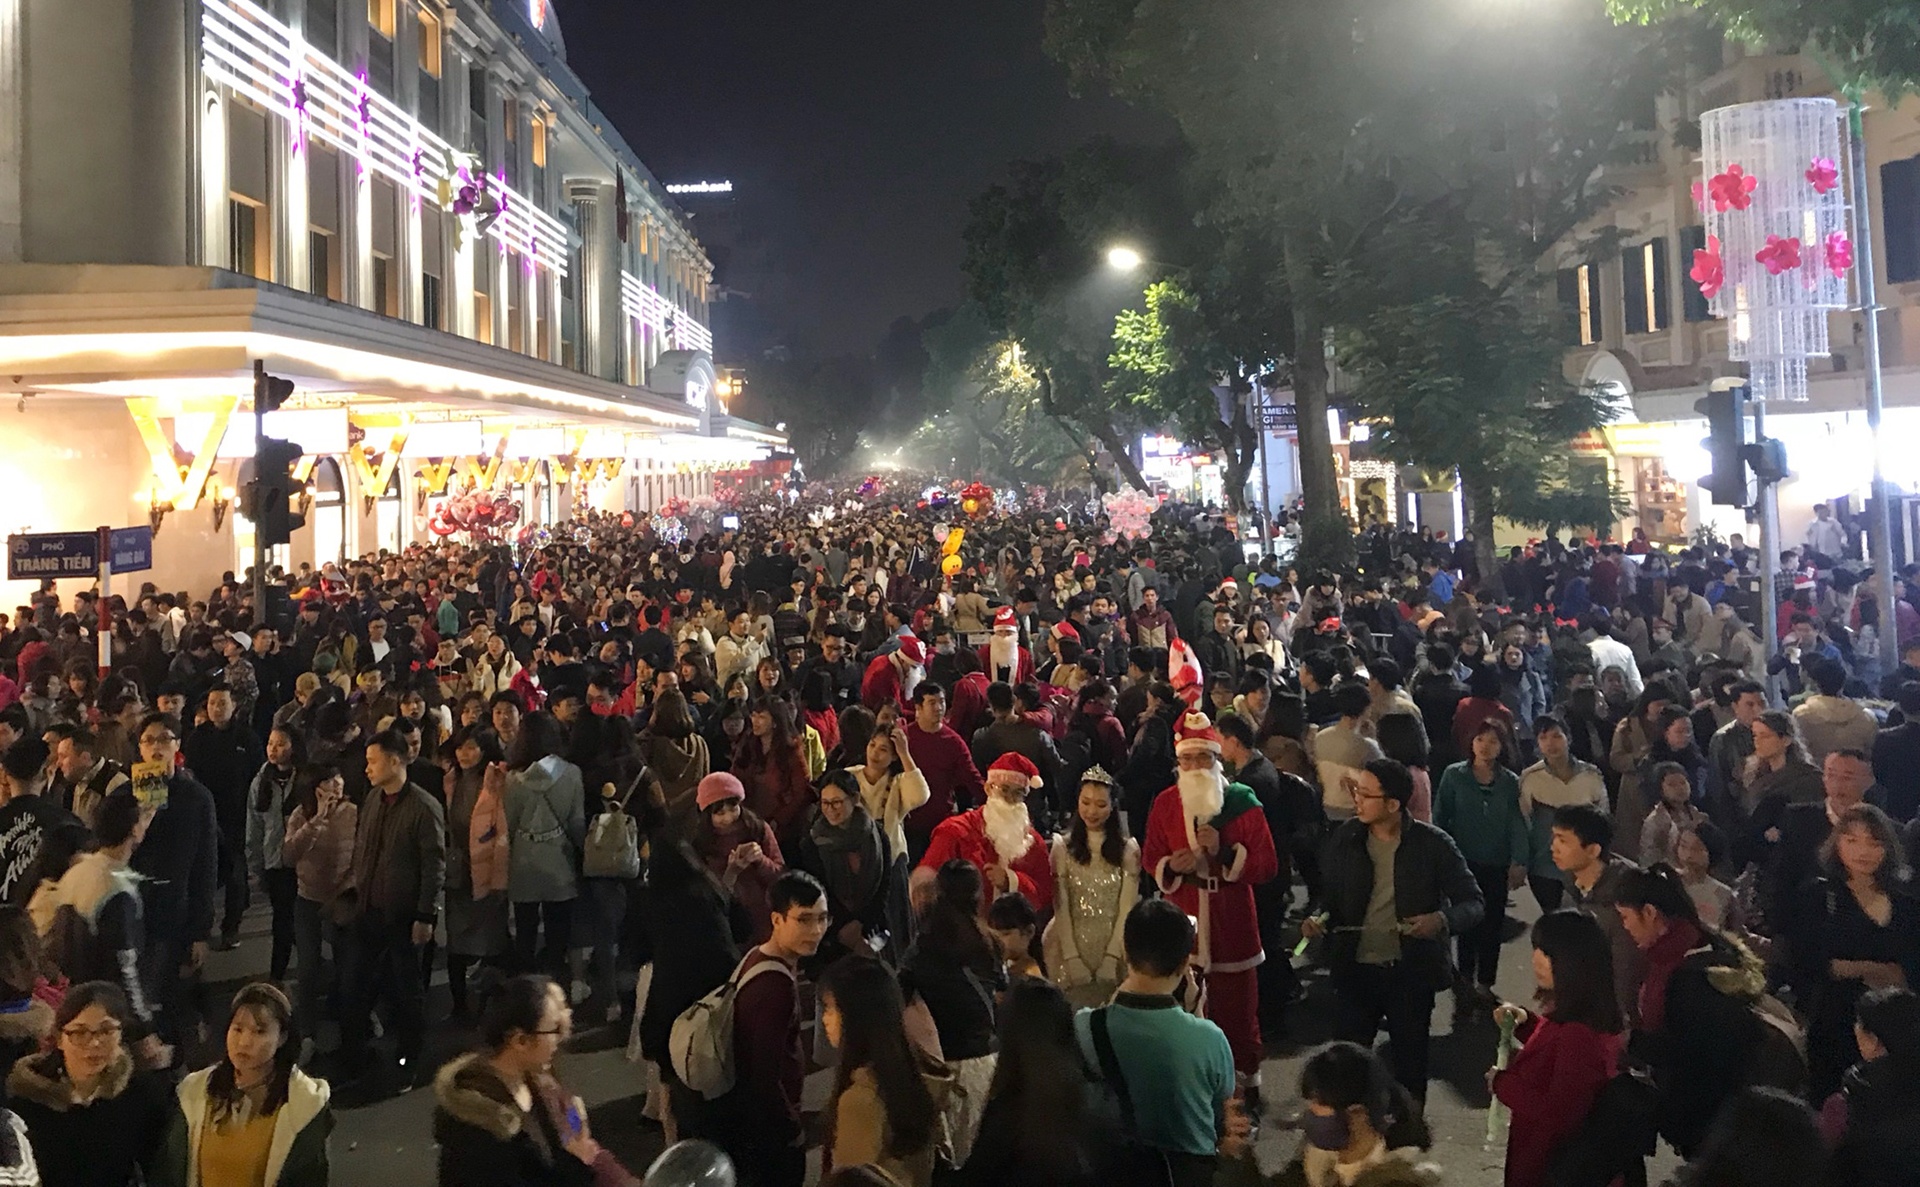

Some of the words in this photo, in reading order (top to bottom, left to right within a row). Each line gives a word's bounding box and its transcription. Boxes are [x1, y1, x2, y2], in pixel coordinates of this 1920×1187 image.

[1169, 457, 1182, 467] 12
[42, 539, 65, 551] PHỐ
[15, 555, 59, 572] TRÀNG
